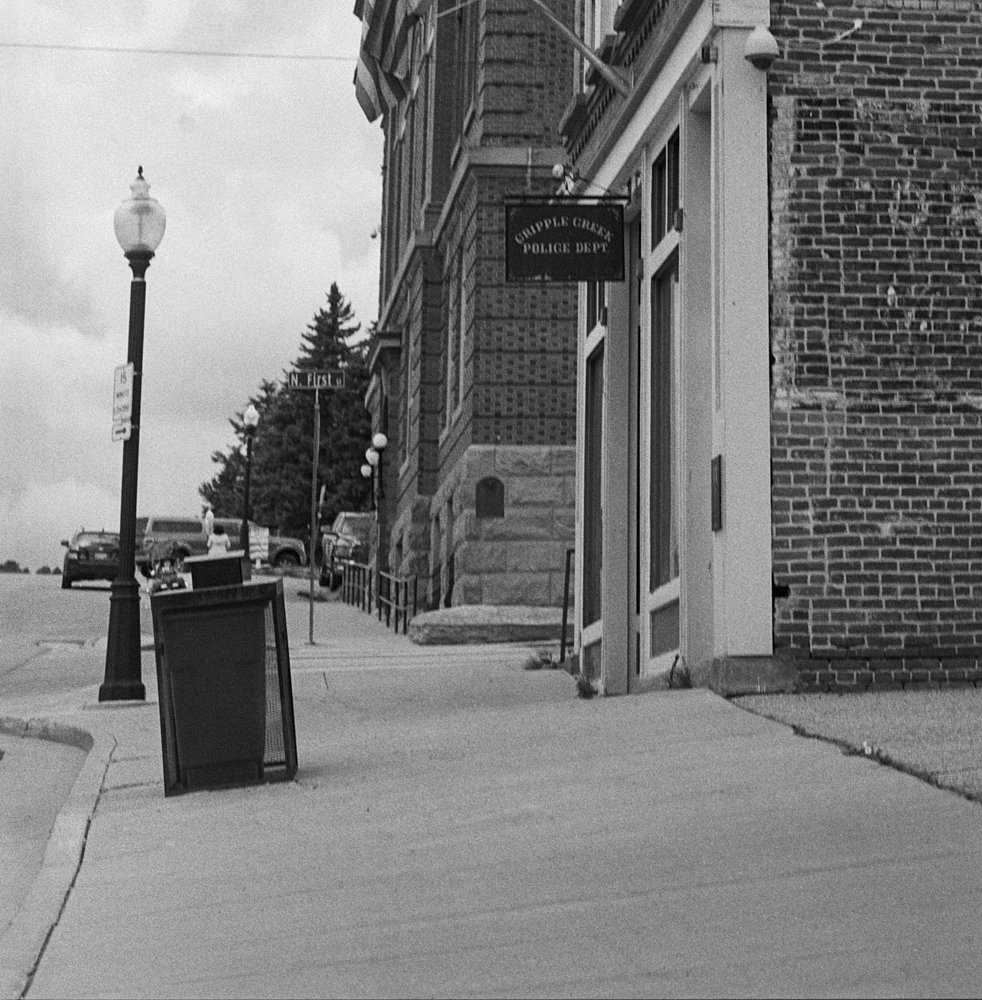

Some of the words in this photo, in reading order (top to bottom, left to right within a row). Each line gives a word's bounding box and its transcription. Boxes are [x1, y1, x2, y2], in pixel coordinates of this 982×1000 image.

[514, 216, 569, 245] CRIPPLE
[572, 217, 614, 242] CREEK
[523, 242, 571, 255] POLICE
[307, 371, 332, 388] First
